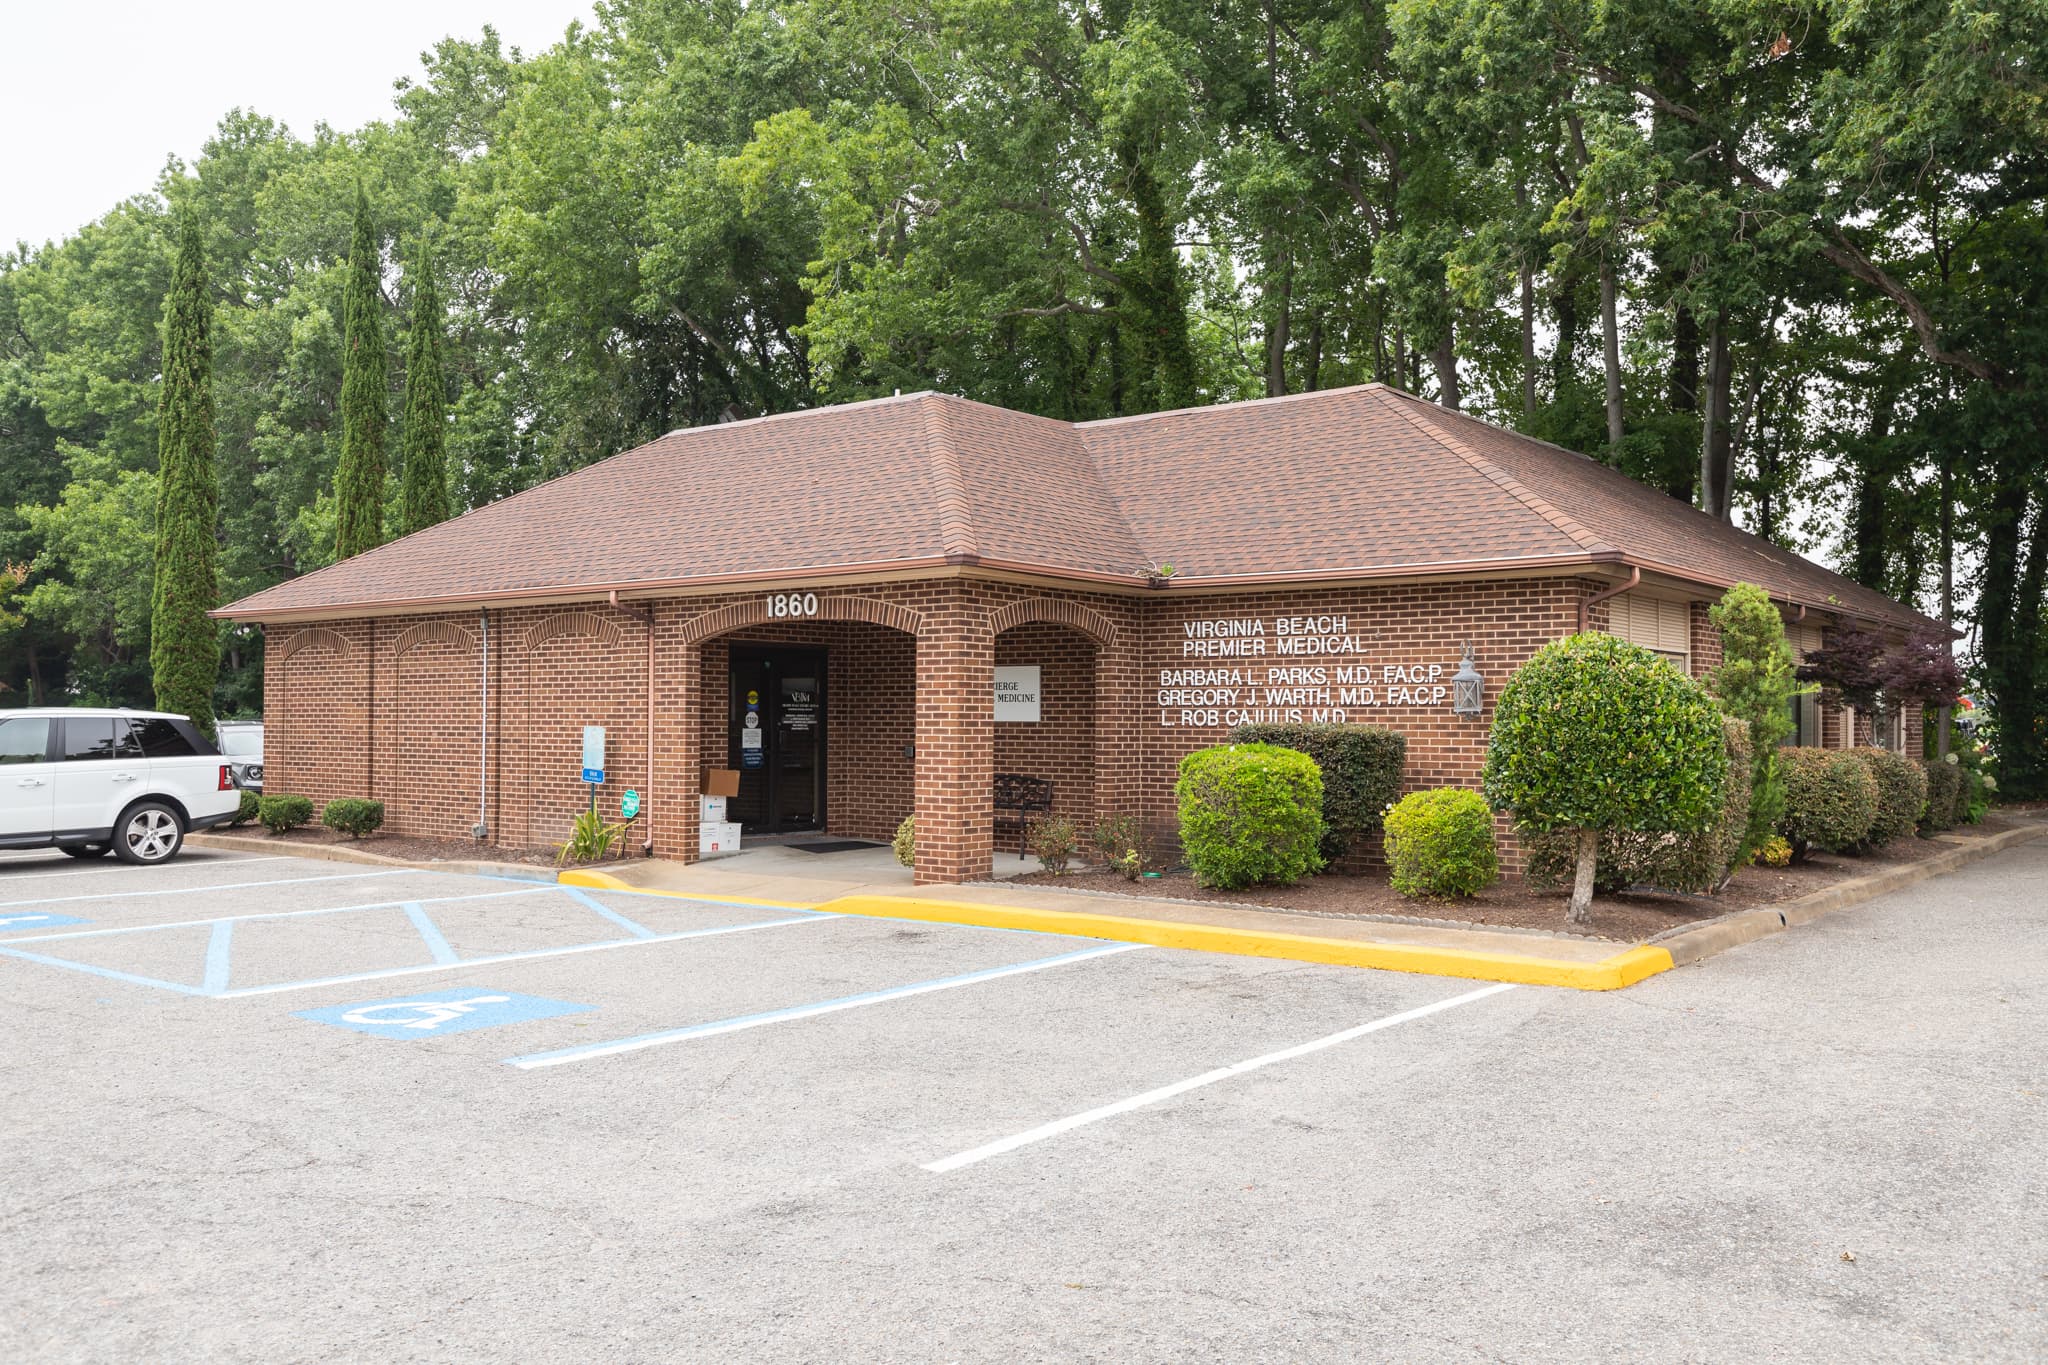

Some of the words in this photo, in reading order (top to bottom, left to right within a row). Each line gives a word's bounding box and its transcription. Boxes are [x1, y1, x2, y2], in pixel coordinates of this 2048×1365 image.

[767, 593, 818, 617] 1860
[1183, 619, 1265, 638] VIRGINIA
[1276, 616, 1347, 636] BEACH
[1183, 639, 1266, 657] PREMIER
[1277, 636, 1367, 655] MEDICAL
[994, 681, 1019, 691] IERGE
[1160, 669, 1242, 686] BARBARA
[1247, 668, 1263, 686] L.
[1268, 667, 1331, 686] PARKS,
[1336, 666, 1377, 686] M.D.,
[997, 693, 1036, 703] MEDICINE
[1157, 688, 1240, 706] GREGORY
[1246, 688, 1259, 706] J.
[1265, 687, 1334, 707] WARTH,
[1340, 687, 1381, 707] M.D.,
[1161, 709, 1175, 726] L.
[1181, 709, 1219, 726] ROB
